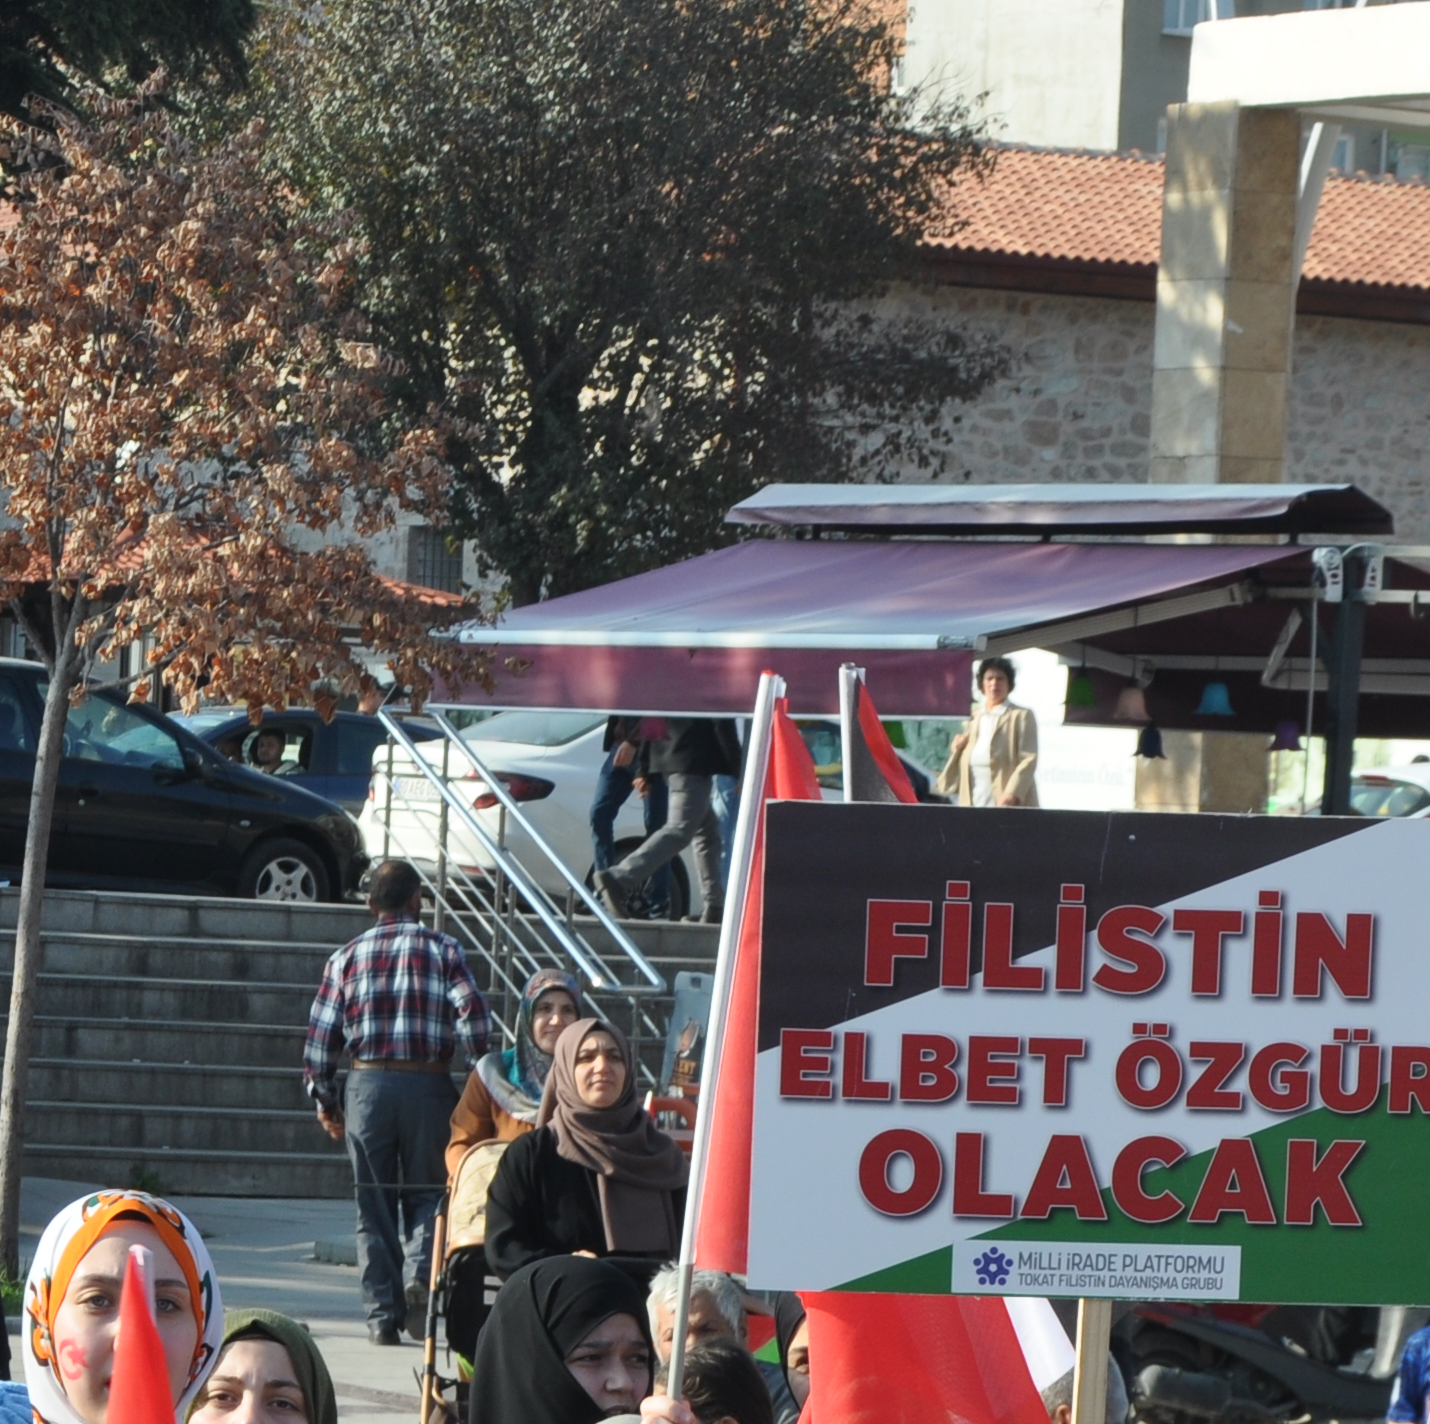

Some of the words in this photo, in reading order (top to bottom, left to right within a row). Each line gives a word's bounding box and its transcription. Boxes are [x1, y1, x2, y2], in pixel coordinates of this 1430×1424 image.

[864, 879, 1377, 1000] FİLİSTİN
[778, 1027, 1087, 1109] ELBET
[857, 1126, 1367, 1227] OLACAK
[1017, 1272, 1056, 1287] TOKAT
[1108, 1275, 1179, 1291] DAYANIŞMA
[1181, 1276, 1223, 1291] GRUBU
[1122, 1254, 1226, 1275] PLATFORMU
